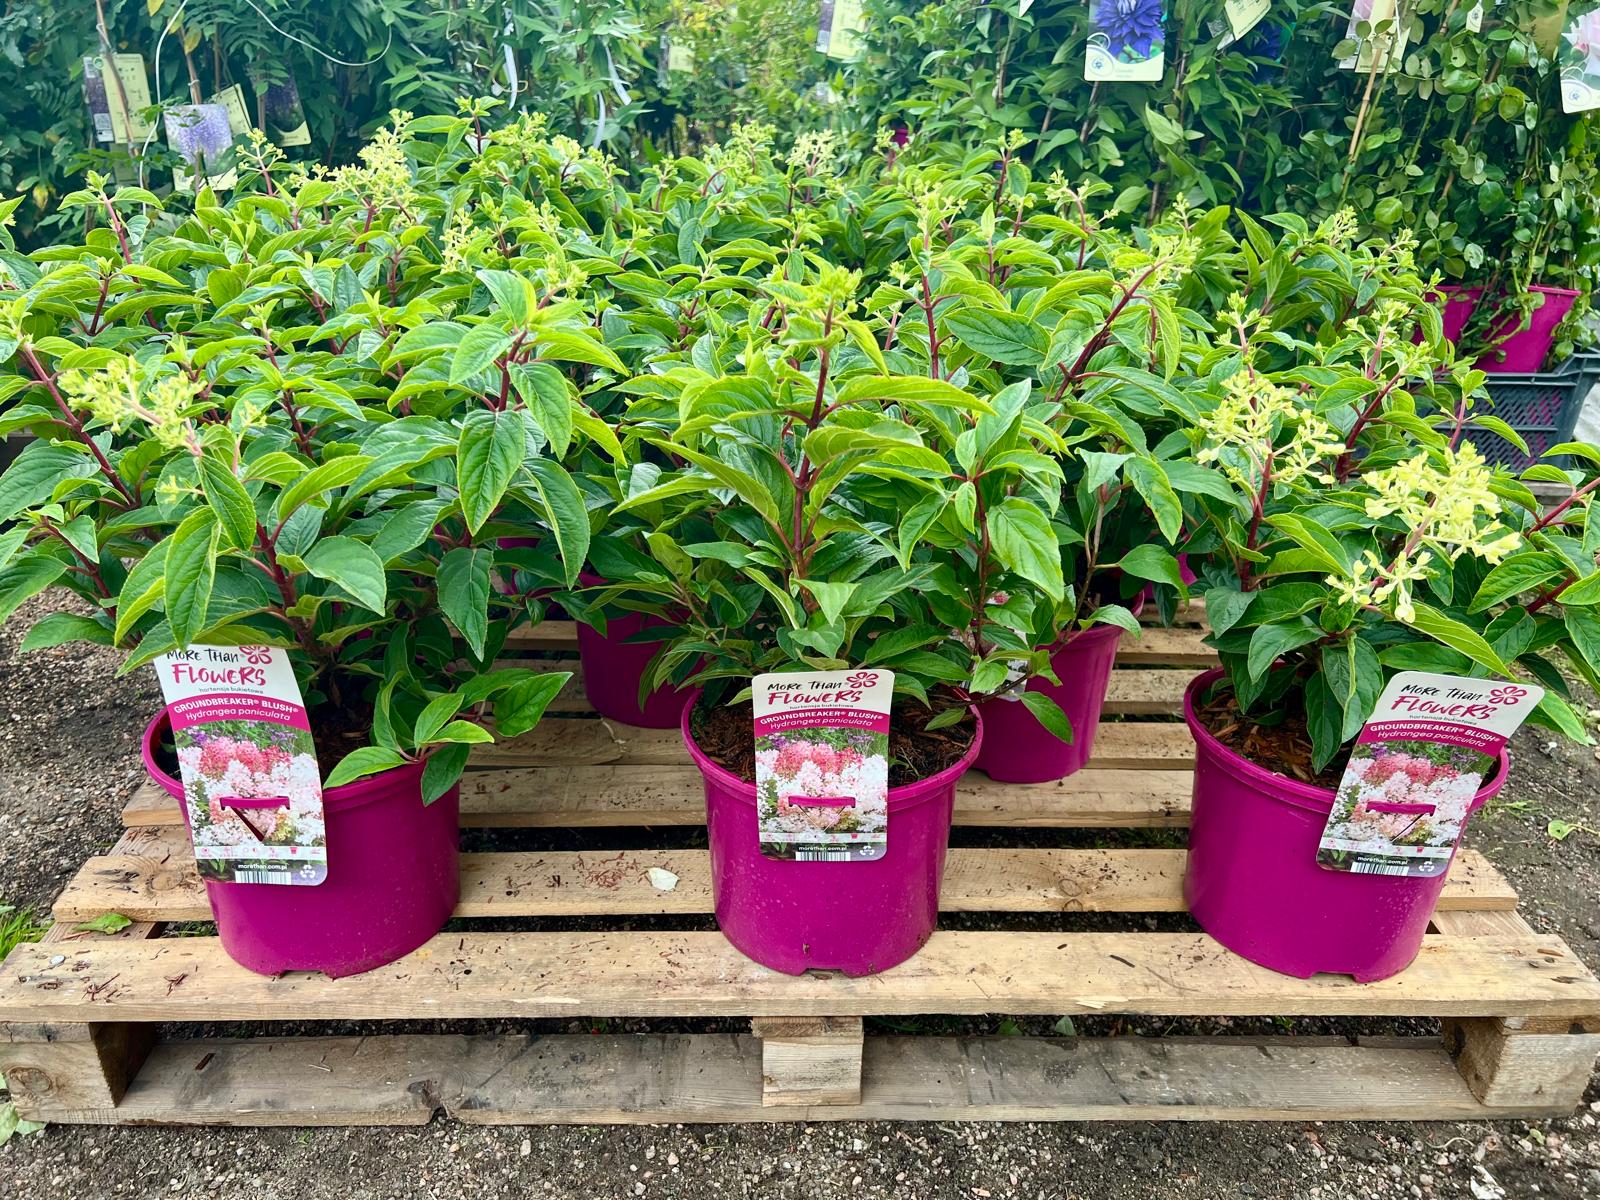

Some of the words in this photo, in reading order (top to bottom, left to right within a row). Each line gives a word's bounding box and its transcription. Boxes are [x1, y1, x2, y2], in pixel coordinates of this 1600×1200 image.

[186, 708, 236, 721] Hydrangea
[238, 709, 291, 721] paniculata
[770, 718, 821, 729] Hydrangea
[821, 718, 873, 727] paniculata
[1377, 731, 1433, 739] Hydrangea
[1433, 733, 1486, 747] paniculata
